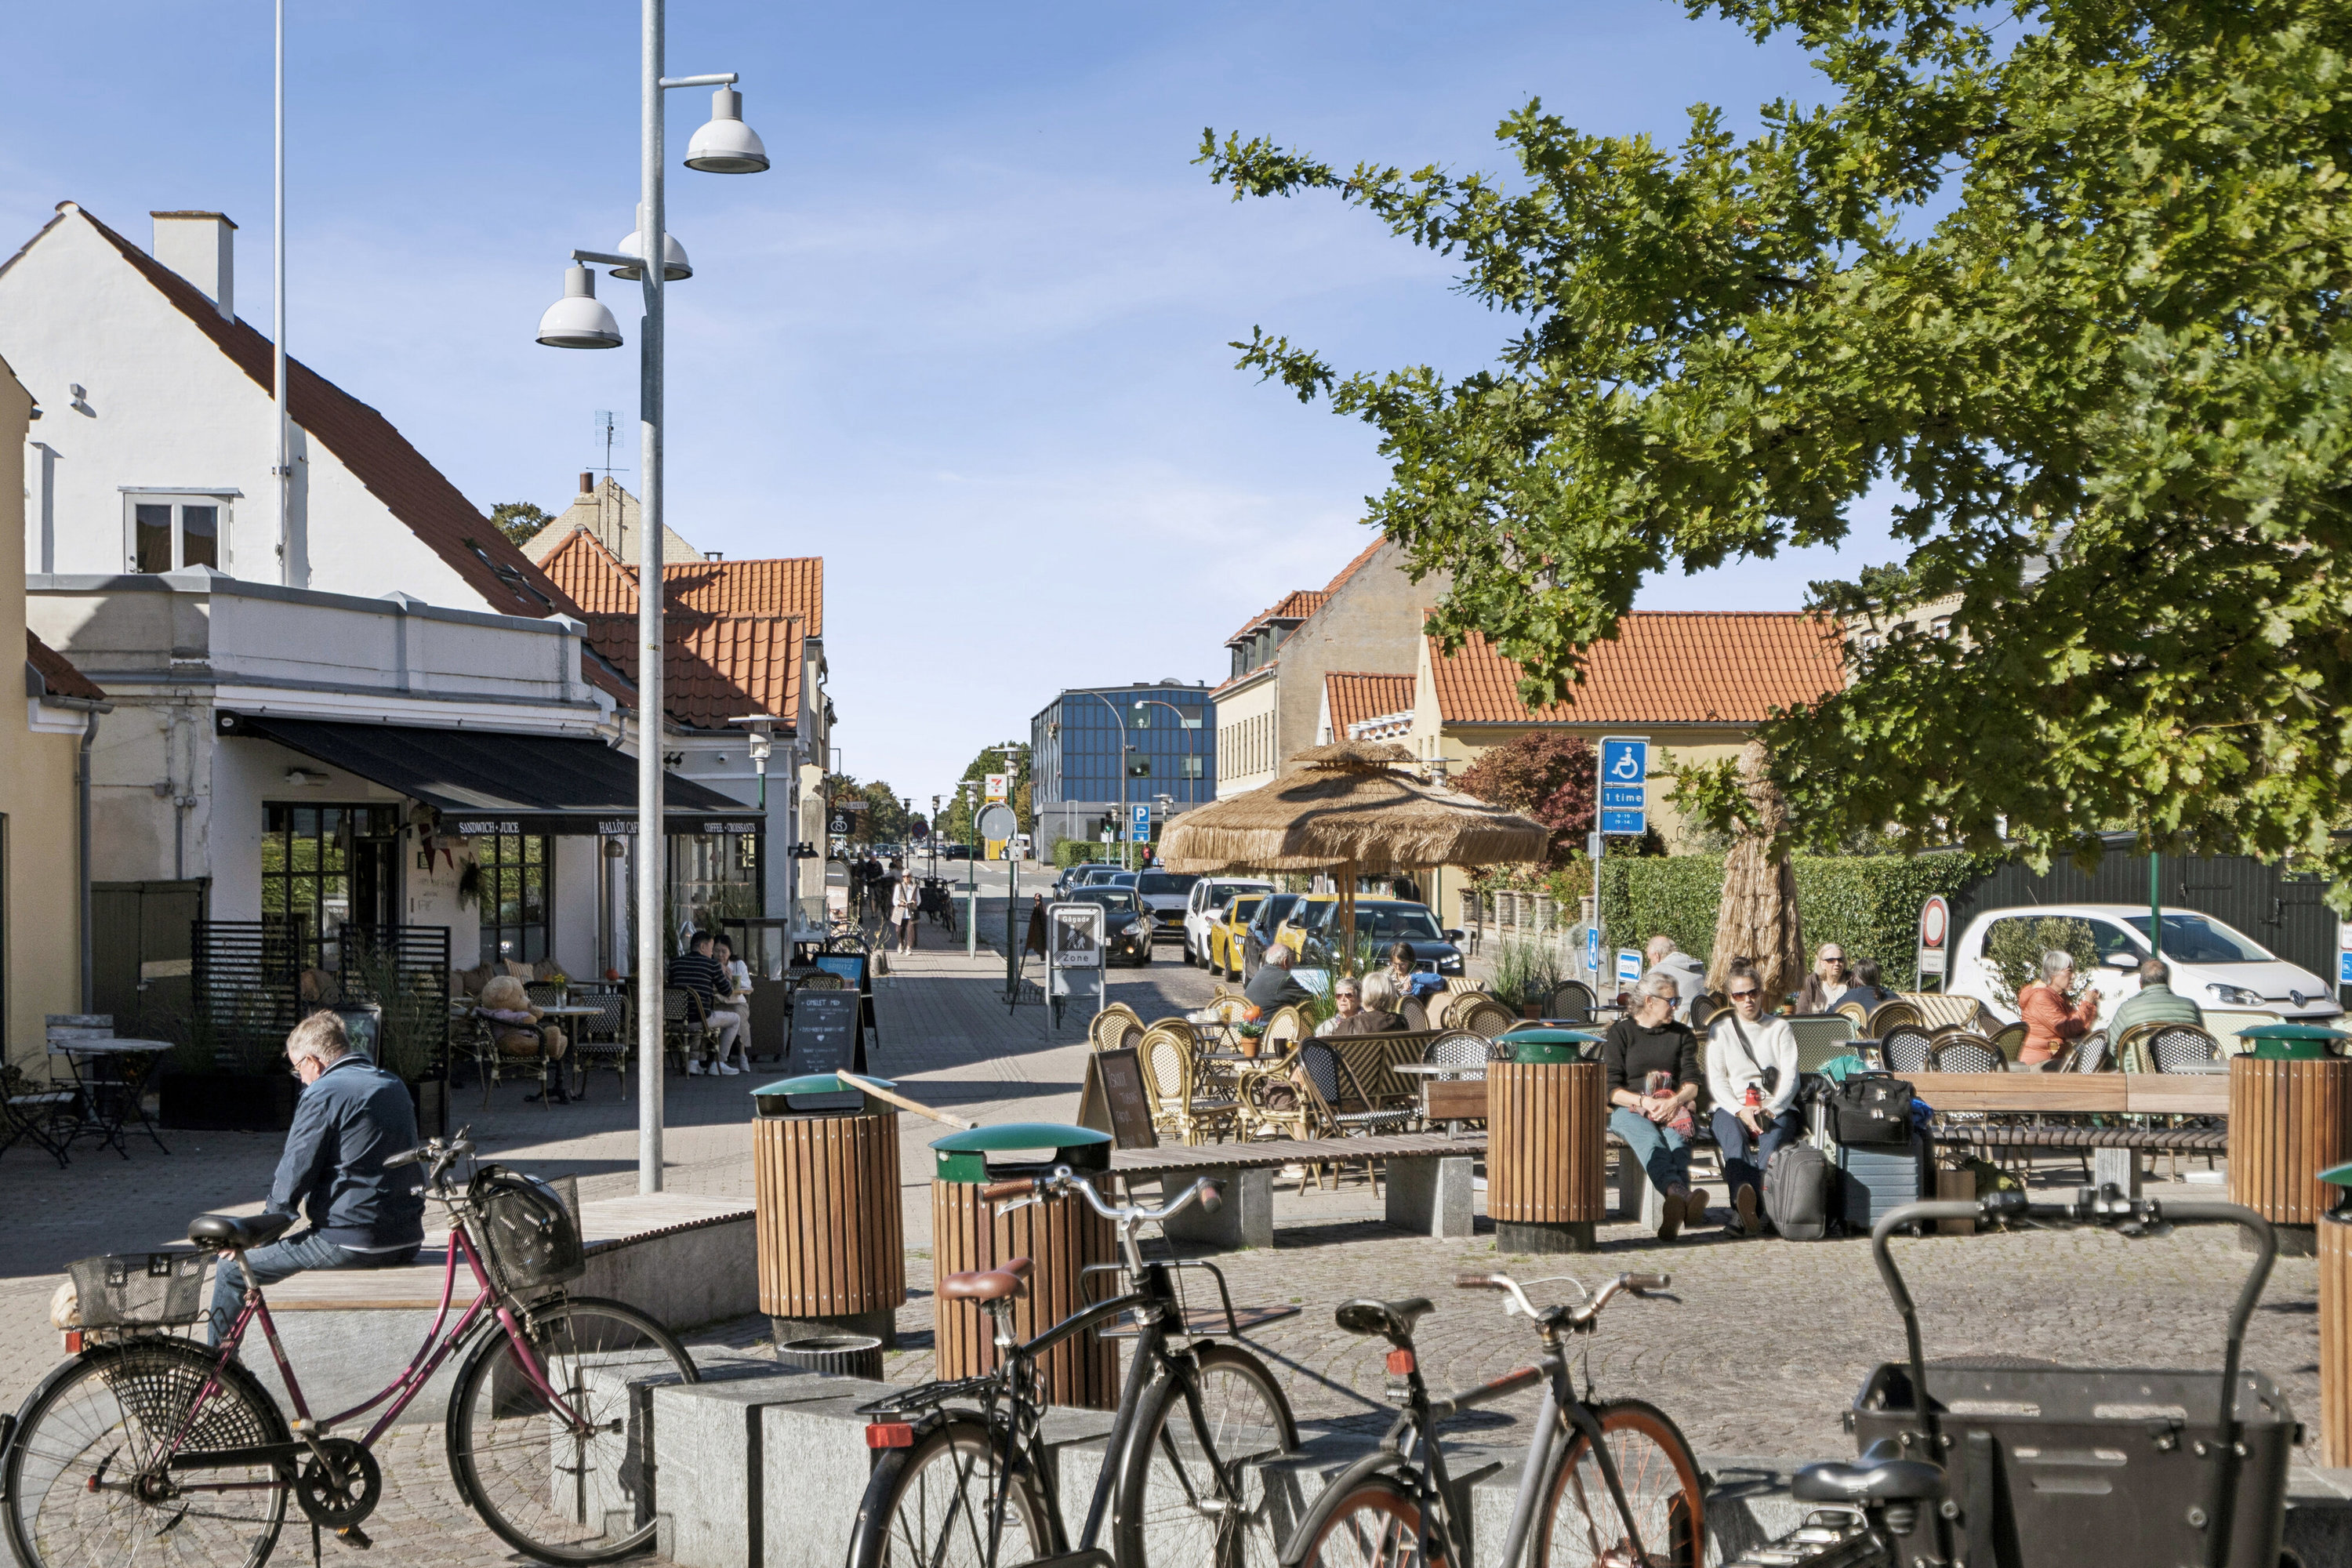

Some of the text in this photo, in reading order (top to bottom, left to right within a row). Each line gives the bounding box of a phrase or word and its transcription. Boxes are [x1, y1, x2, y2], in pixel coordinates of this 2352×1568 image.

[1606, 793, 1642, 802] 1 time
[1136, 808, 1146, 822] P
[459, 822, 520, 833] SANDWICH JUICE
[704, 822, 756, 833] COFFEE CROISSANTS
[1063, 953, 1089, 962] Zone
